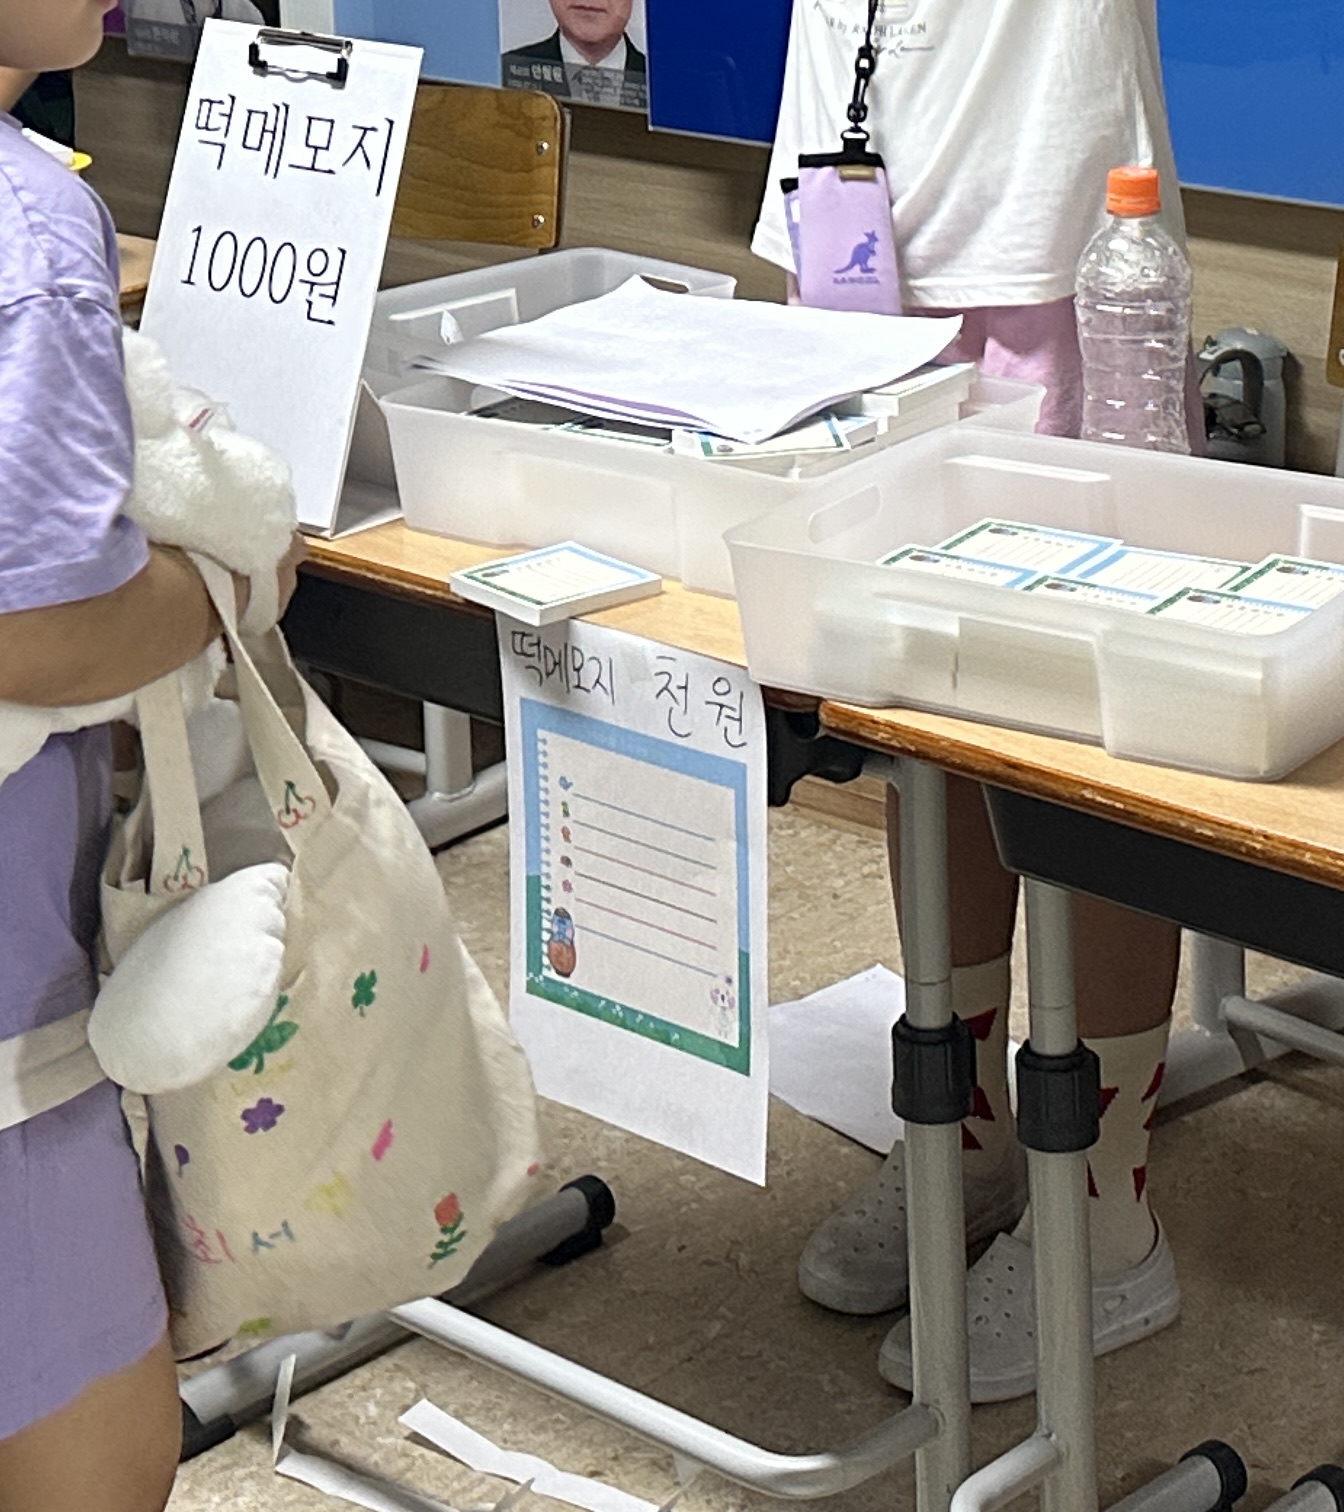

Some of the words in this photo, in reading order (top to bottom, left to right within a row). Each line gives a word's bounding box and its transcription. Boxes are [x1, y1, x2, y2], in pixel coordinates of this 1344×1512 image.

[193, 92, 397, 197] 떡메모지
[179, 224, 348, 326] 1000원
[510, 629, 618, 705] 떡메모지
[654, 654, 748, 749] 천원
